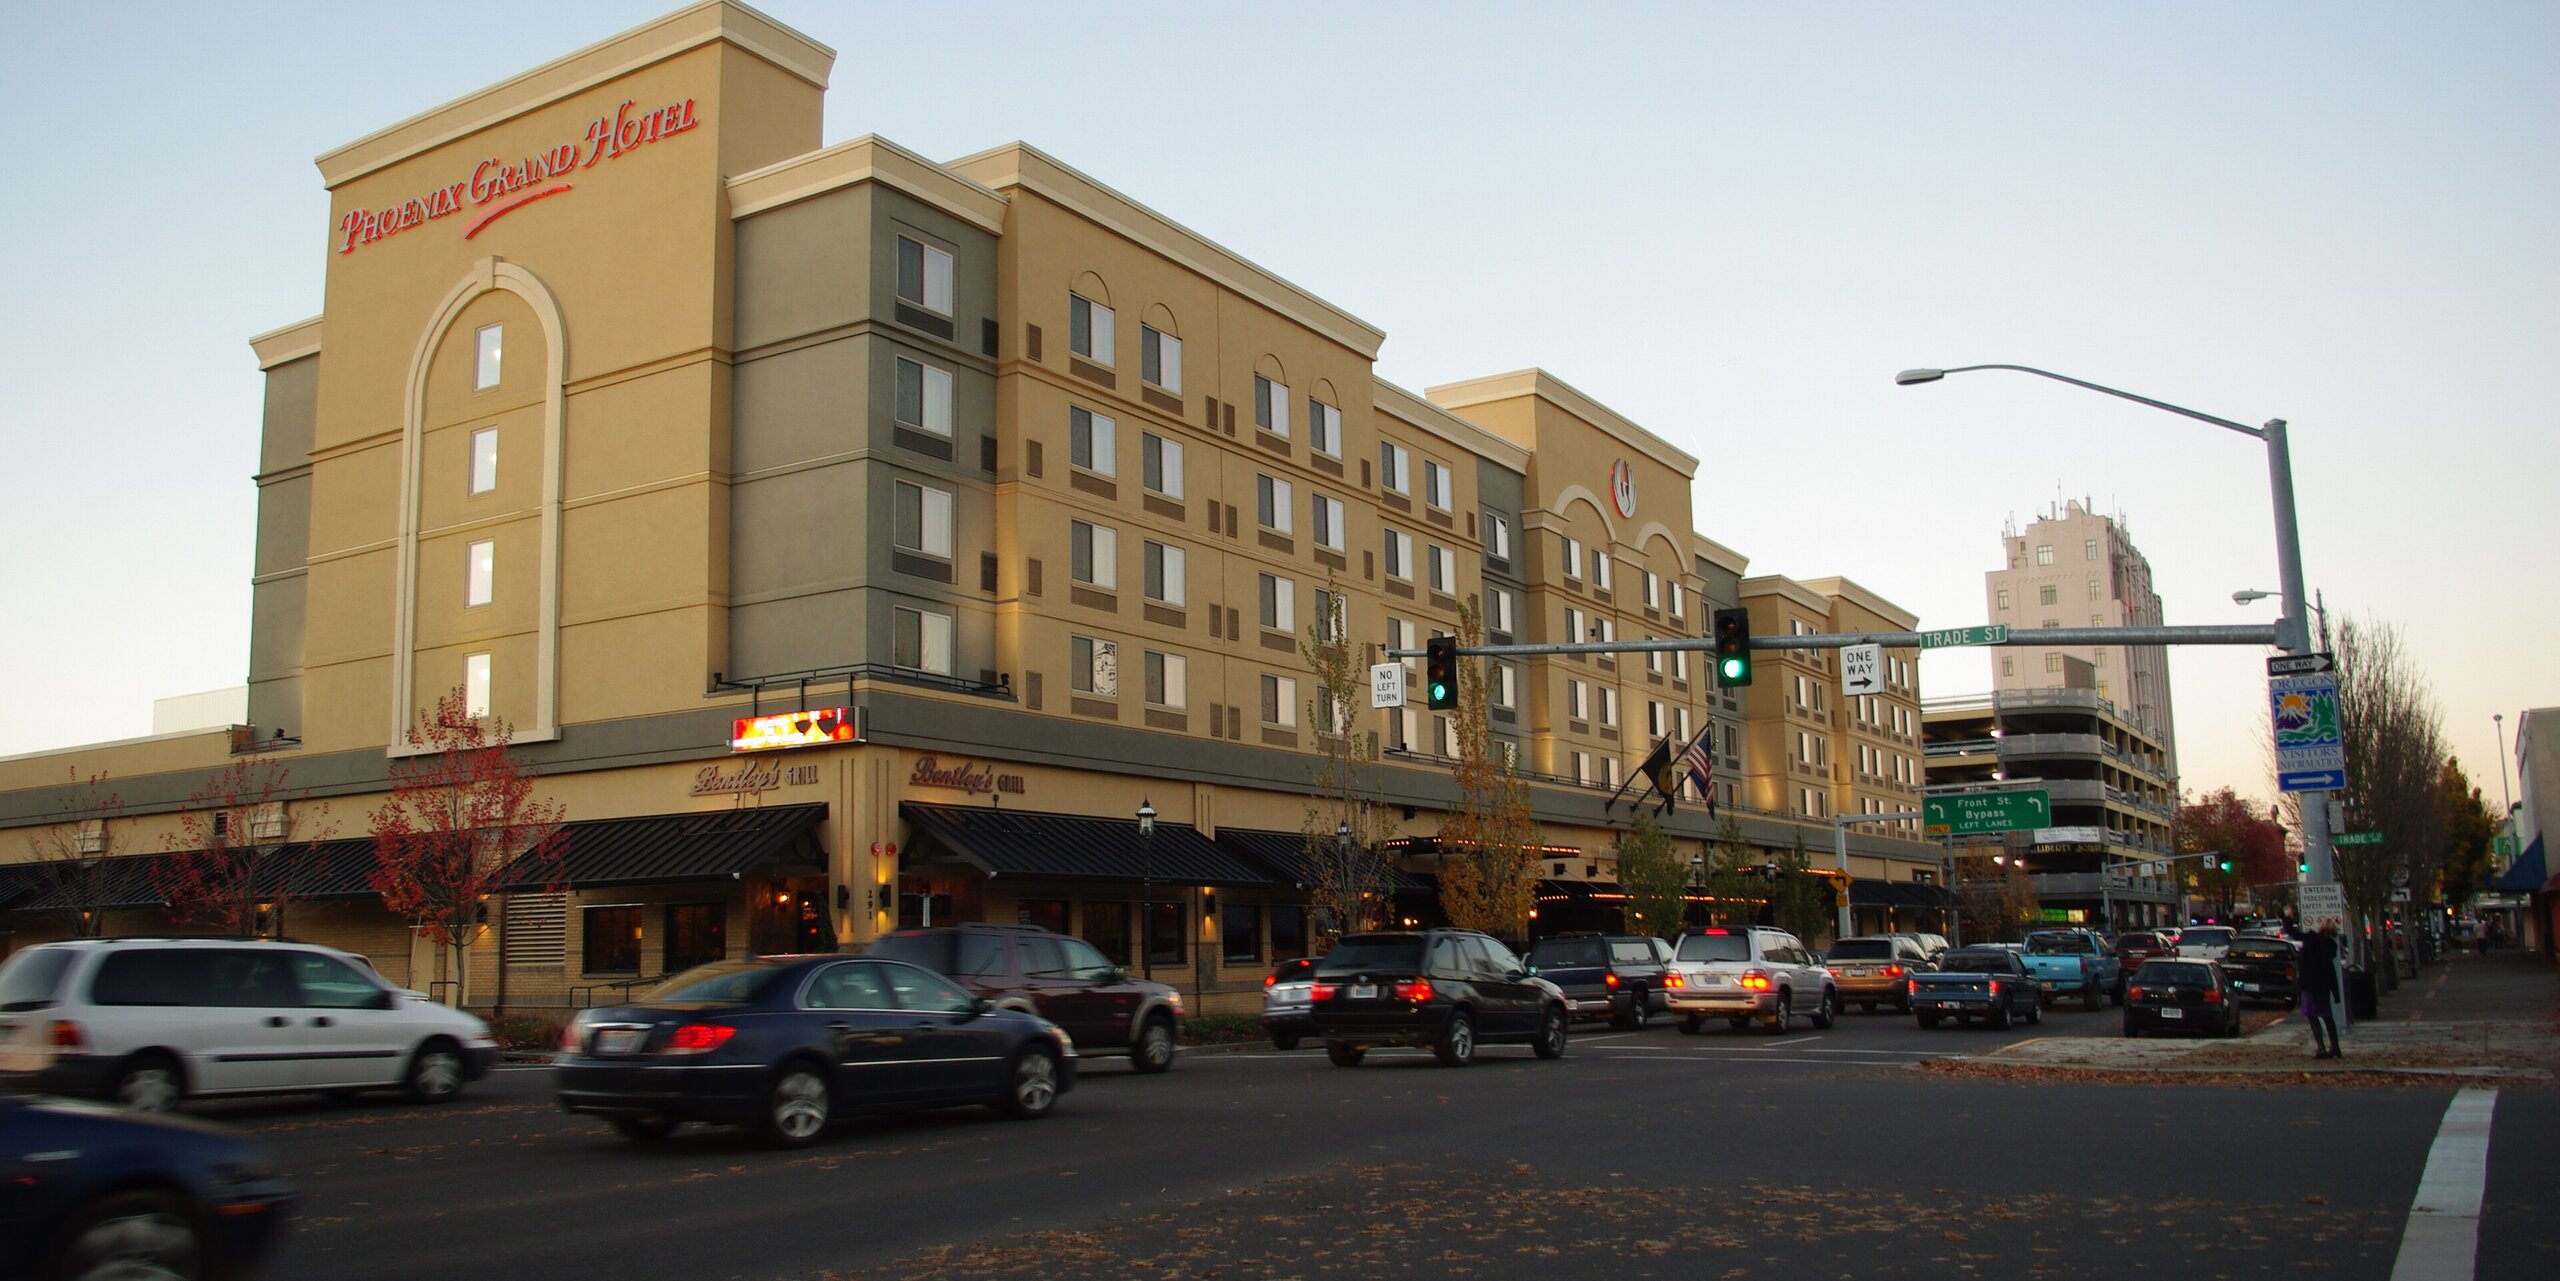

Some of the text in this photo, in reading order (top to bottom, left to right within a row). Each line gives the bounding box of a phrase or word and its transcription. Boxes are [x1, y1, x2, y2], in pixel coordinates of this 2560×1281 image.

[338, 98, 700, 256] PHOENIX GRAND HOTEL
[1924, 626, 2002, 647] TRADE ST
[1846, 650, 1872, 663] ONE
[1846, 663, 1874, 676] WAY
[2273, 659, 2313, 670] ONE WAY
[1380, 670, 1392, 680] NO
[1377, 682, 1396, 691] LEFT
[2271, 675, 2334, 690] OREGON
[1377, 693, 1397, 702] TURN
[2281, 747, 2338, 758] VISITORS
[2278, 757, 2343, 769] NFORMATION
[691, 758, 819, 796] Bentley's GRILL
[909, 753, 1025, 796] Bentley's GRILL
[1957, 797, 2012, 808] Front St.
[1966, 810, 2006, 819] Bypass
[1959, 819, 2014, 830] LEFT LANES
[2338, 833, 2367, 845] TRADE
[2303, 886, 2337, 894] ENTERING
[2303, 894, 2339, 902] PEDESTRIAN
[2302, 902, 2341, 910] SAFETY AREA
